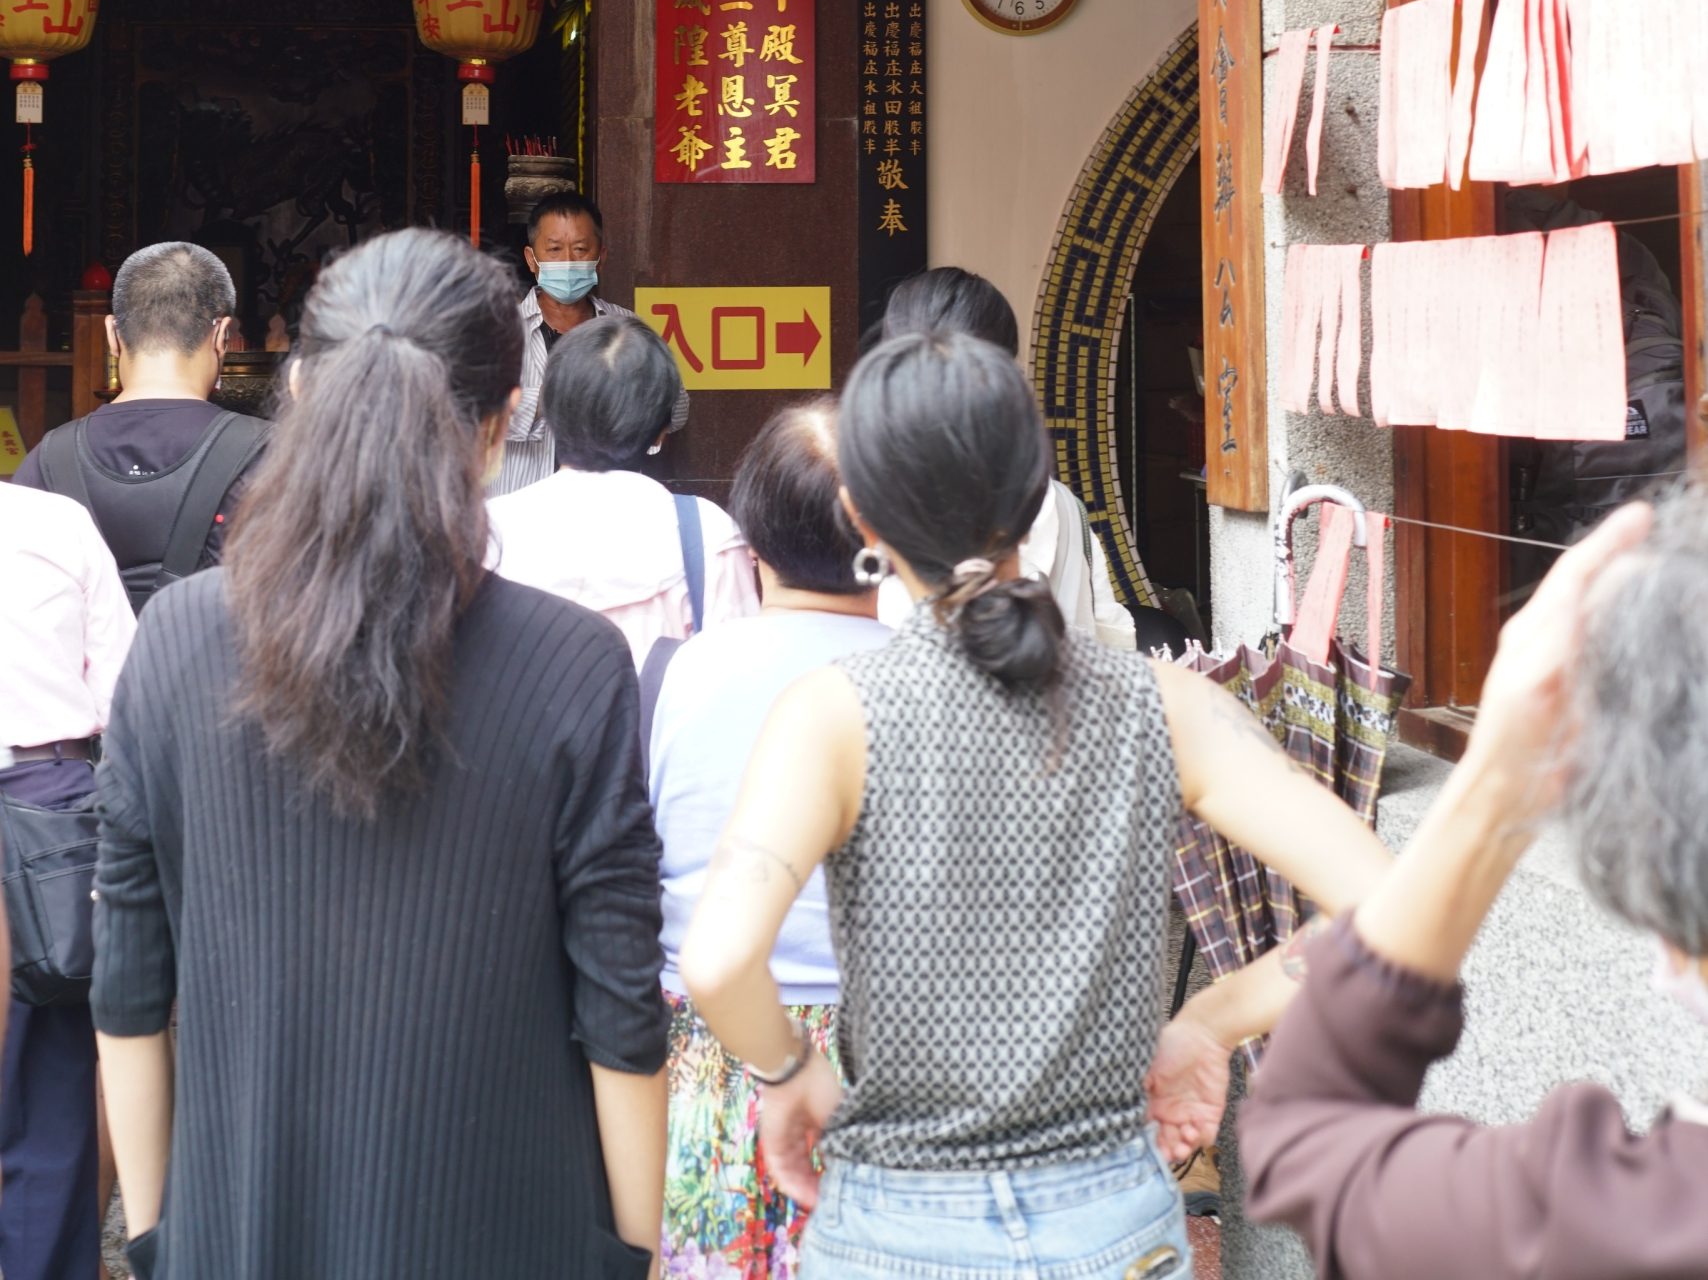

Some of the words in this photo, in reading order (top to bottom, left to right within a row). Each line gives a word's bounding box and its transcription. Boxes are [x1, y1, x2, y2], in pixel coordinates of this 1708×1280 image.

[1015, 1, 1024, 15] 6
[876, 160, 909, 237] 敬奉
[652, 303, 765, 373] 入口
